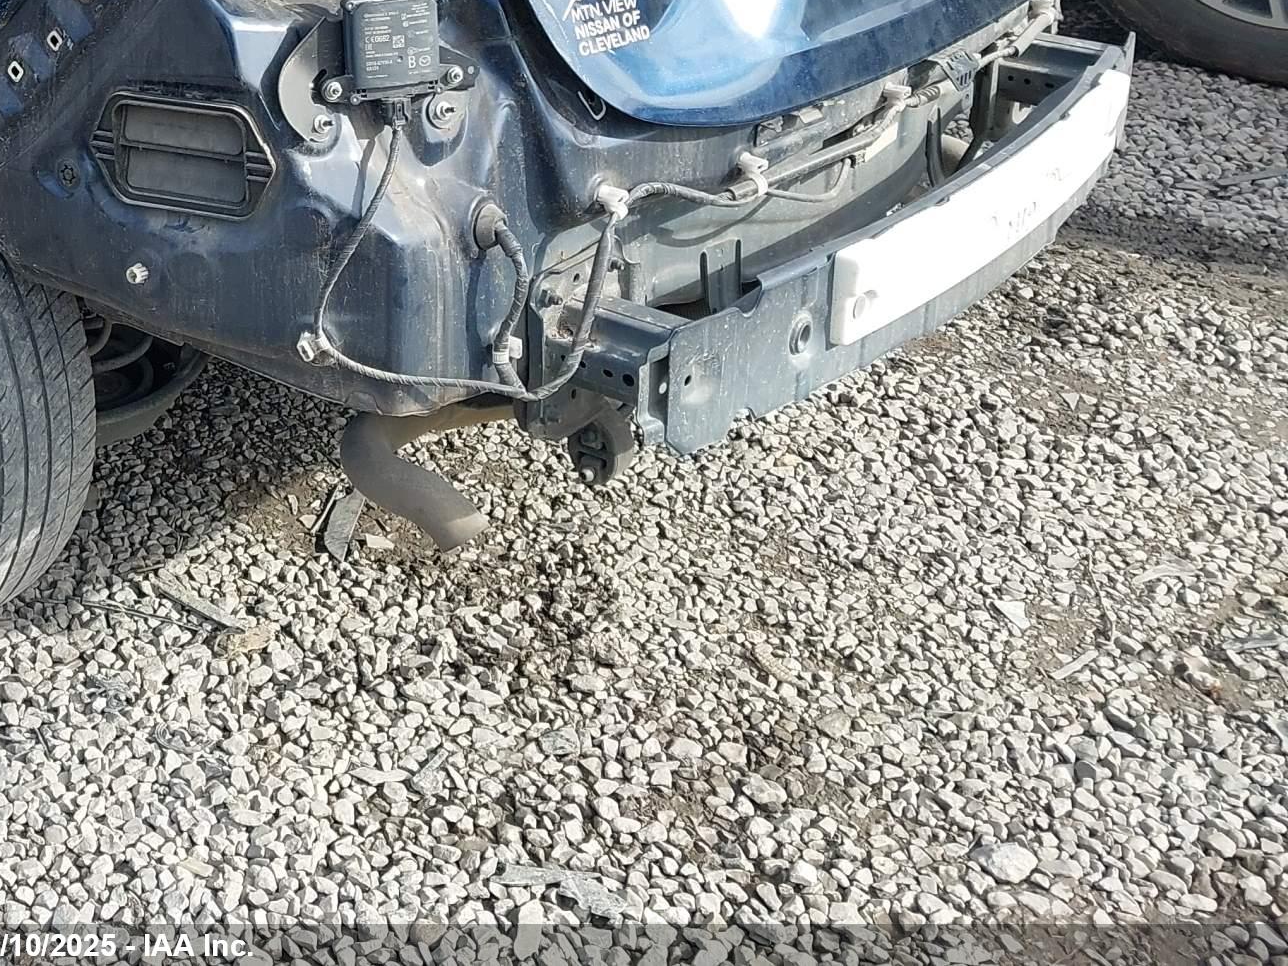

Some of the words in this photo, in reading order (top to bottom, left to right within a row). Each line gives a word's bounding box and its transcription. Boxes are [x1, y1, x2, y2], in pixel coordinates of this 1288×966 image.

[574, 16, 620, 40] NISSAN
[622, 10, 641, 28] OF
[578, 25, 651, 56] CLEVELAND
